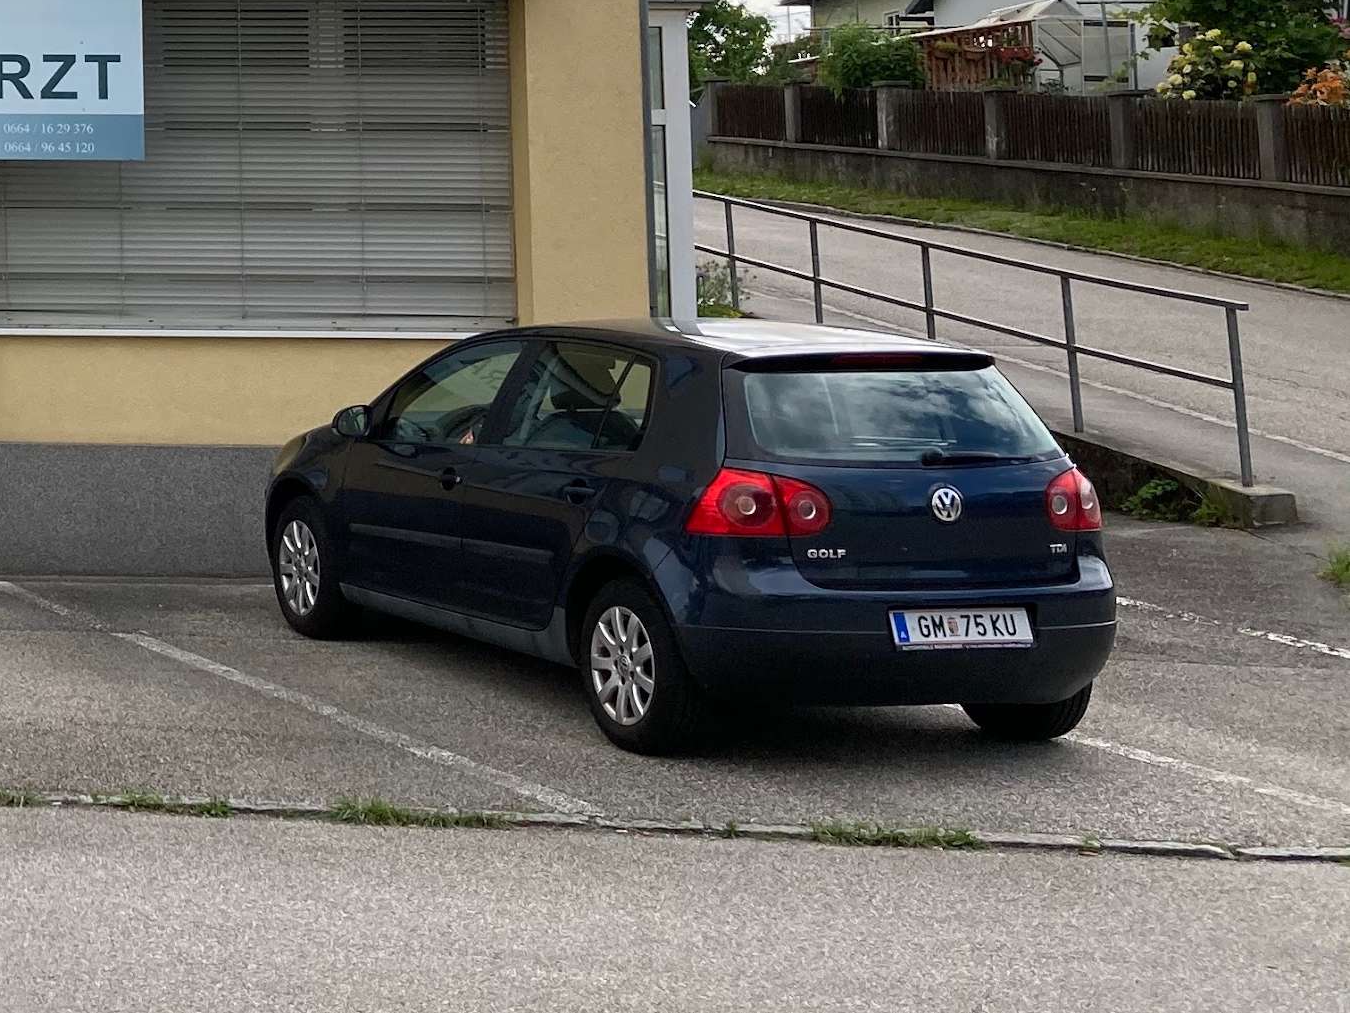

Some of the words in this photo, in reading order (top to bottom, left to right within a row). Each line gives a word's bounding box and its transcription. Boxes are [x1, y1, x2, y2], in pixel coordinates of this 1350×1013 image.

[3, 123, 30, 134] 0664
[41, 123, 54, 134] 16
[57, 123, 70, 134] 29
[73, 123, 94, 134] 376
[4, 141, 31, 153] 0664
[41, 141, 55, 153] 96
[58, 141, 71, 153] 45
[75, 141, 95, 153] 120
[807, 548, 847, 559] GOLF
[1049, 543, 1068, 554] TDI
[917, 614, 947, 638] GM
[960, 614, 987, 637] 75
[990, 613, 1017, 637] KU
